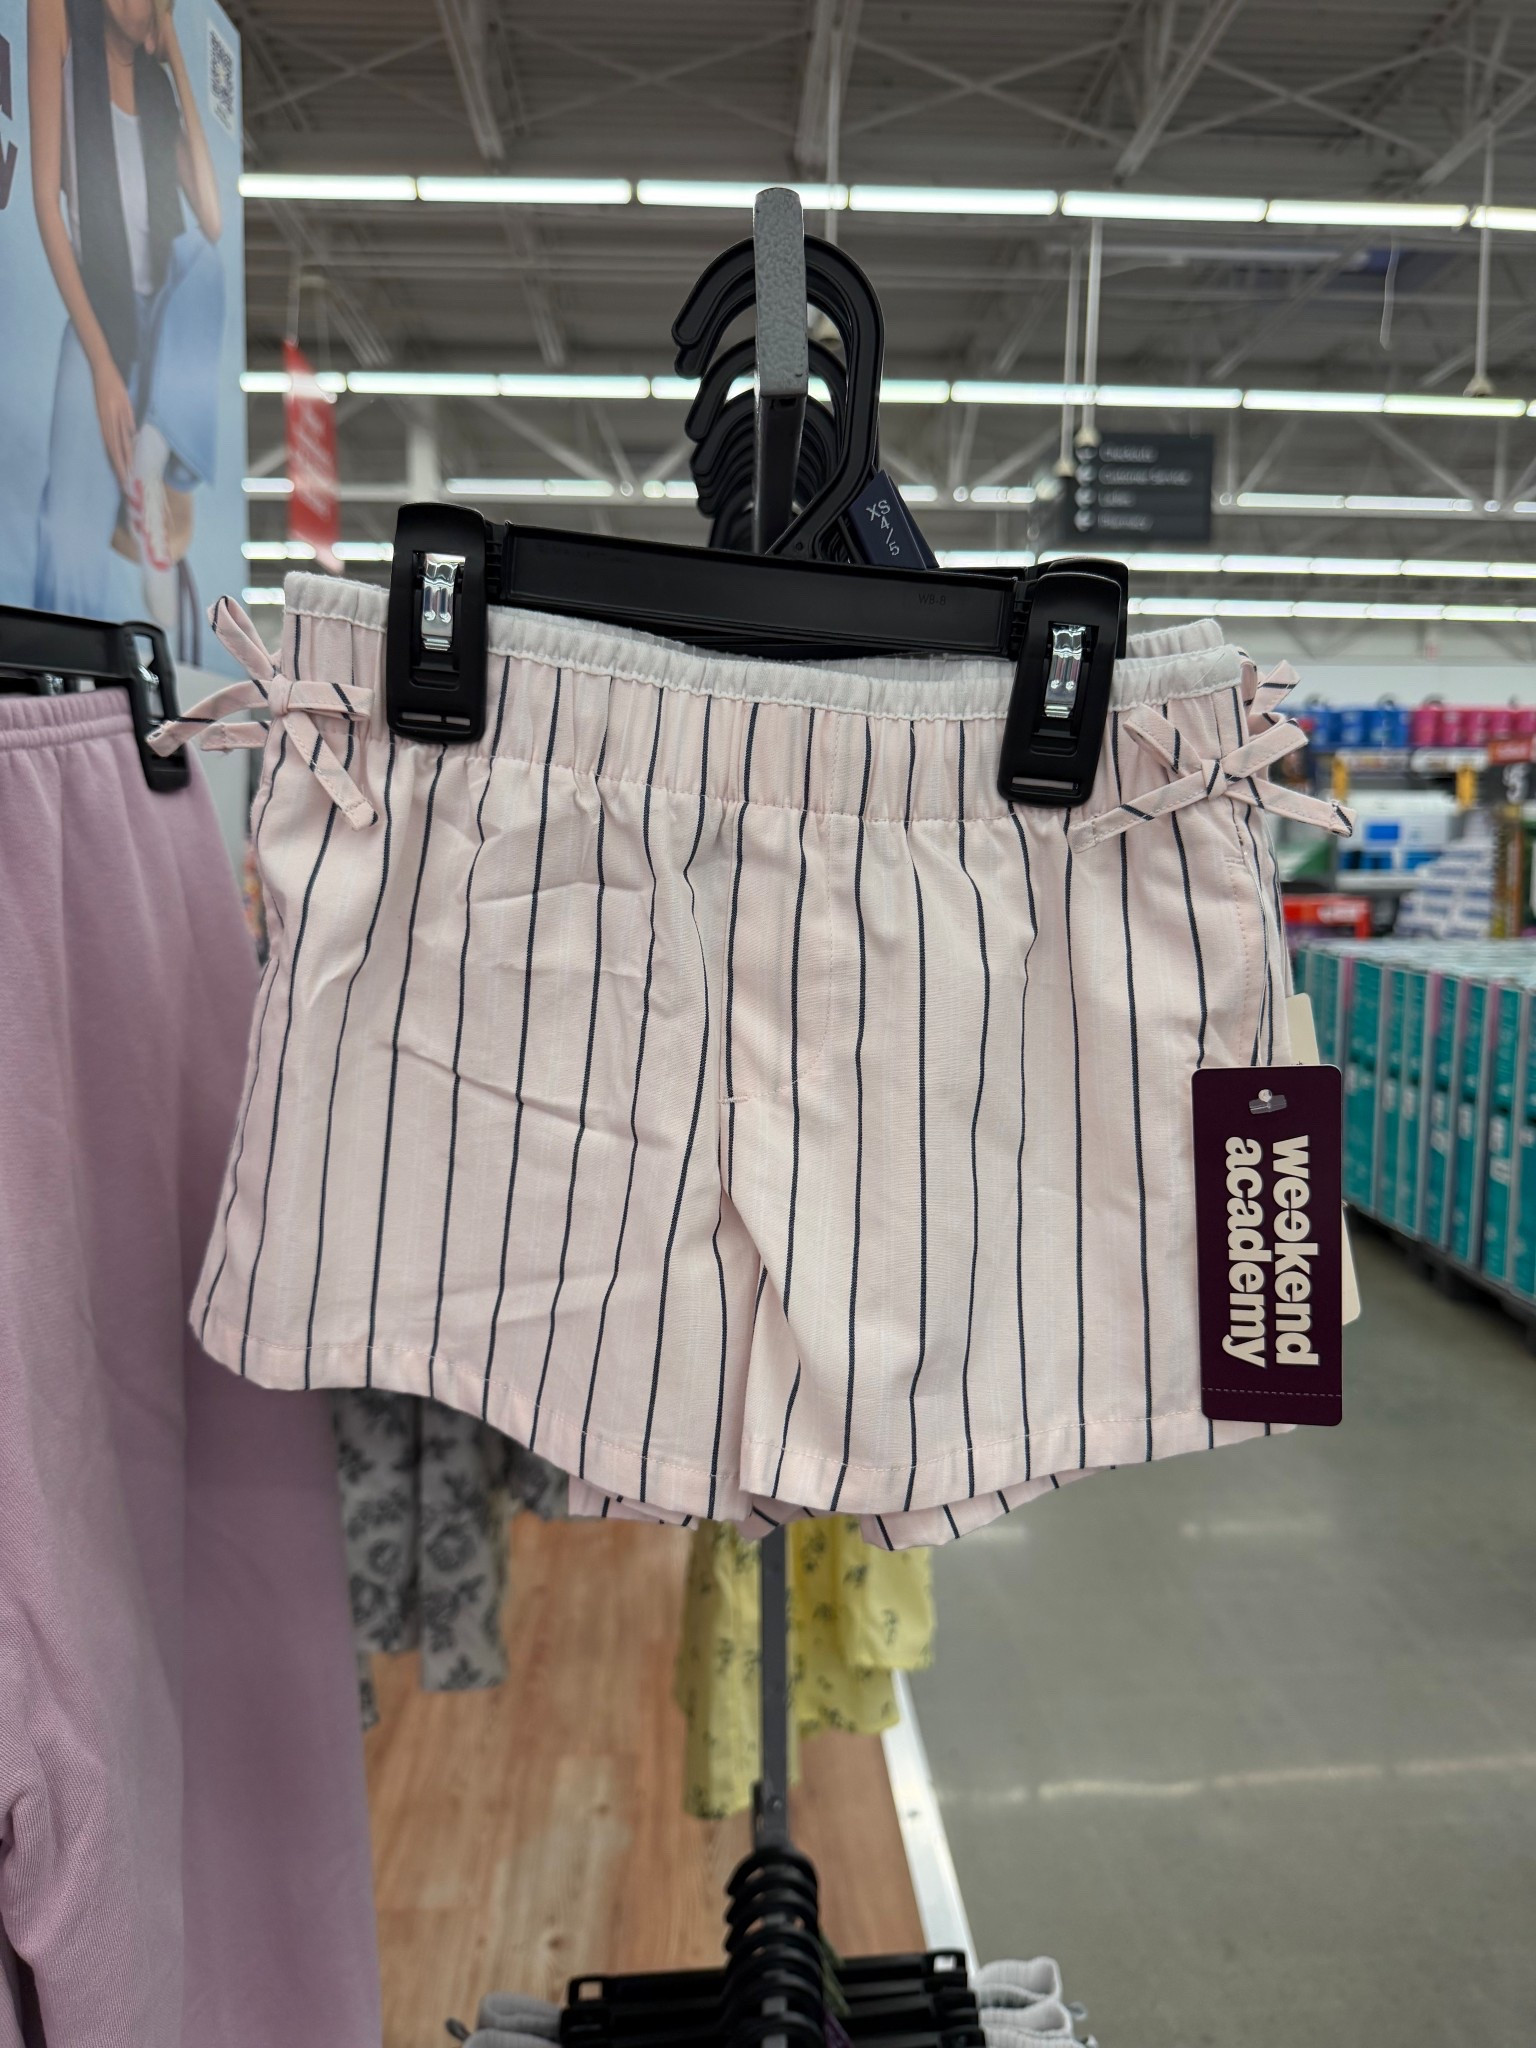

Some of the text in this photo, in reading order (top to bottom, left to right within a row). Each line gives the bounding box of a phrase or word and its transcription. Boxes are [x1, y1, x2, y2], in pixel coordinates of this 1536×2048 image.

[865, 499, 891, 521] XS
[880, 515, 900, 556] 4/5
[1221, 1136, 1271, 1368] academy
[1272, 1134, 1319, 1366] weekend
